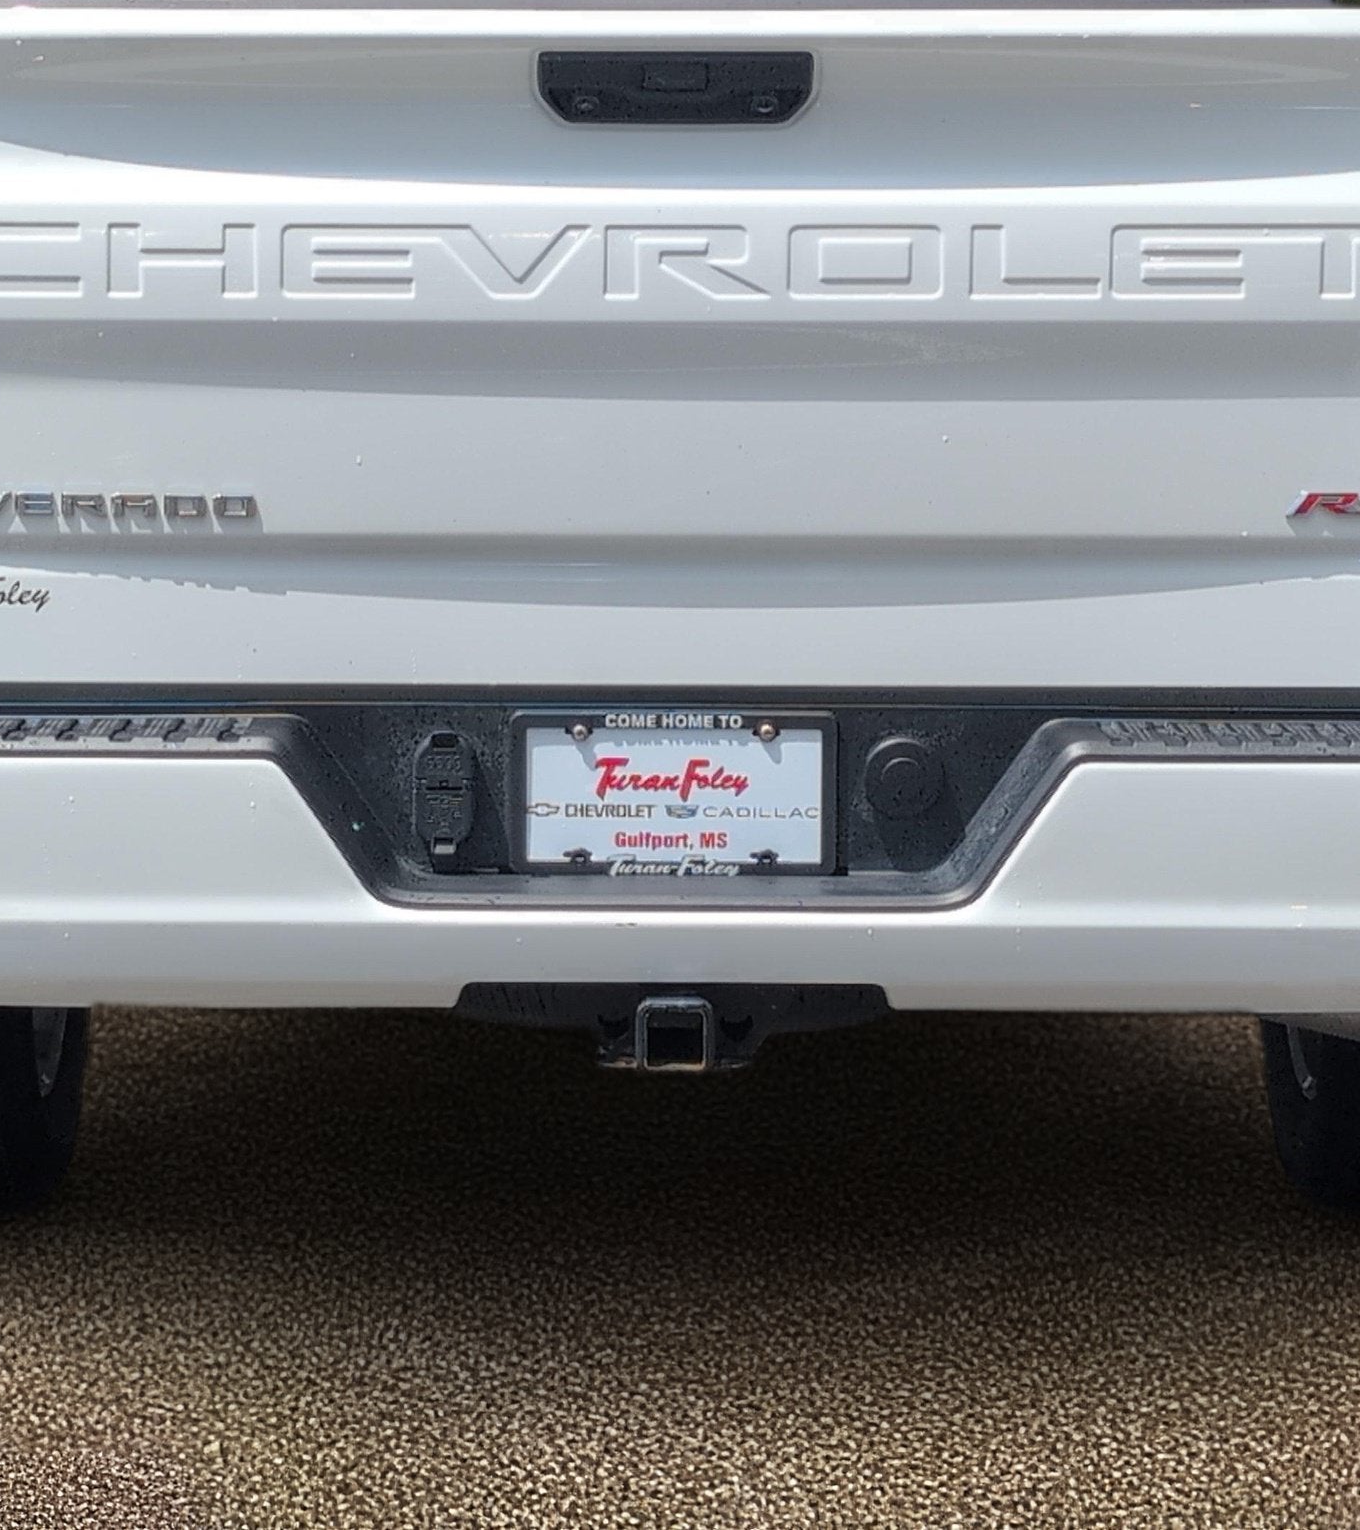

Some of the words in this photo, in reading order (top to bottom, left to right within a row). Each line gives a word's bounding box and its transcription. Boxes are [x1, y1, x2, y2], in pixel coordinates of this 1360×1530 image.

[605, 714, 656, 729] COME
[662, 714, 714, 729] HOME
[719, 714, 743, 729] TO
[565, 803, 655, 819] CHEVROLET
[703, 806, 819, 819] CADILLAC
[614, 831, 694, 850] Gulfport,
[700, 831, 728, 849] MS
